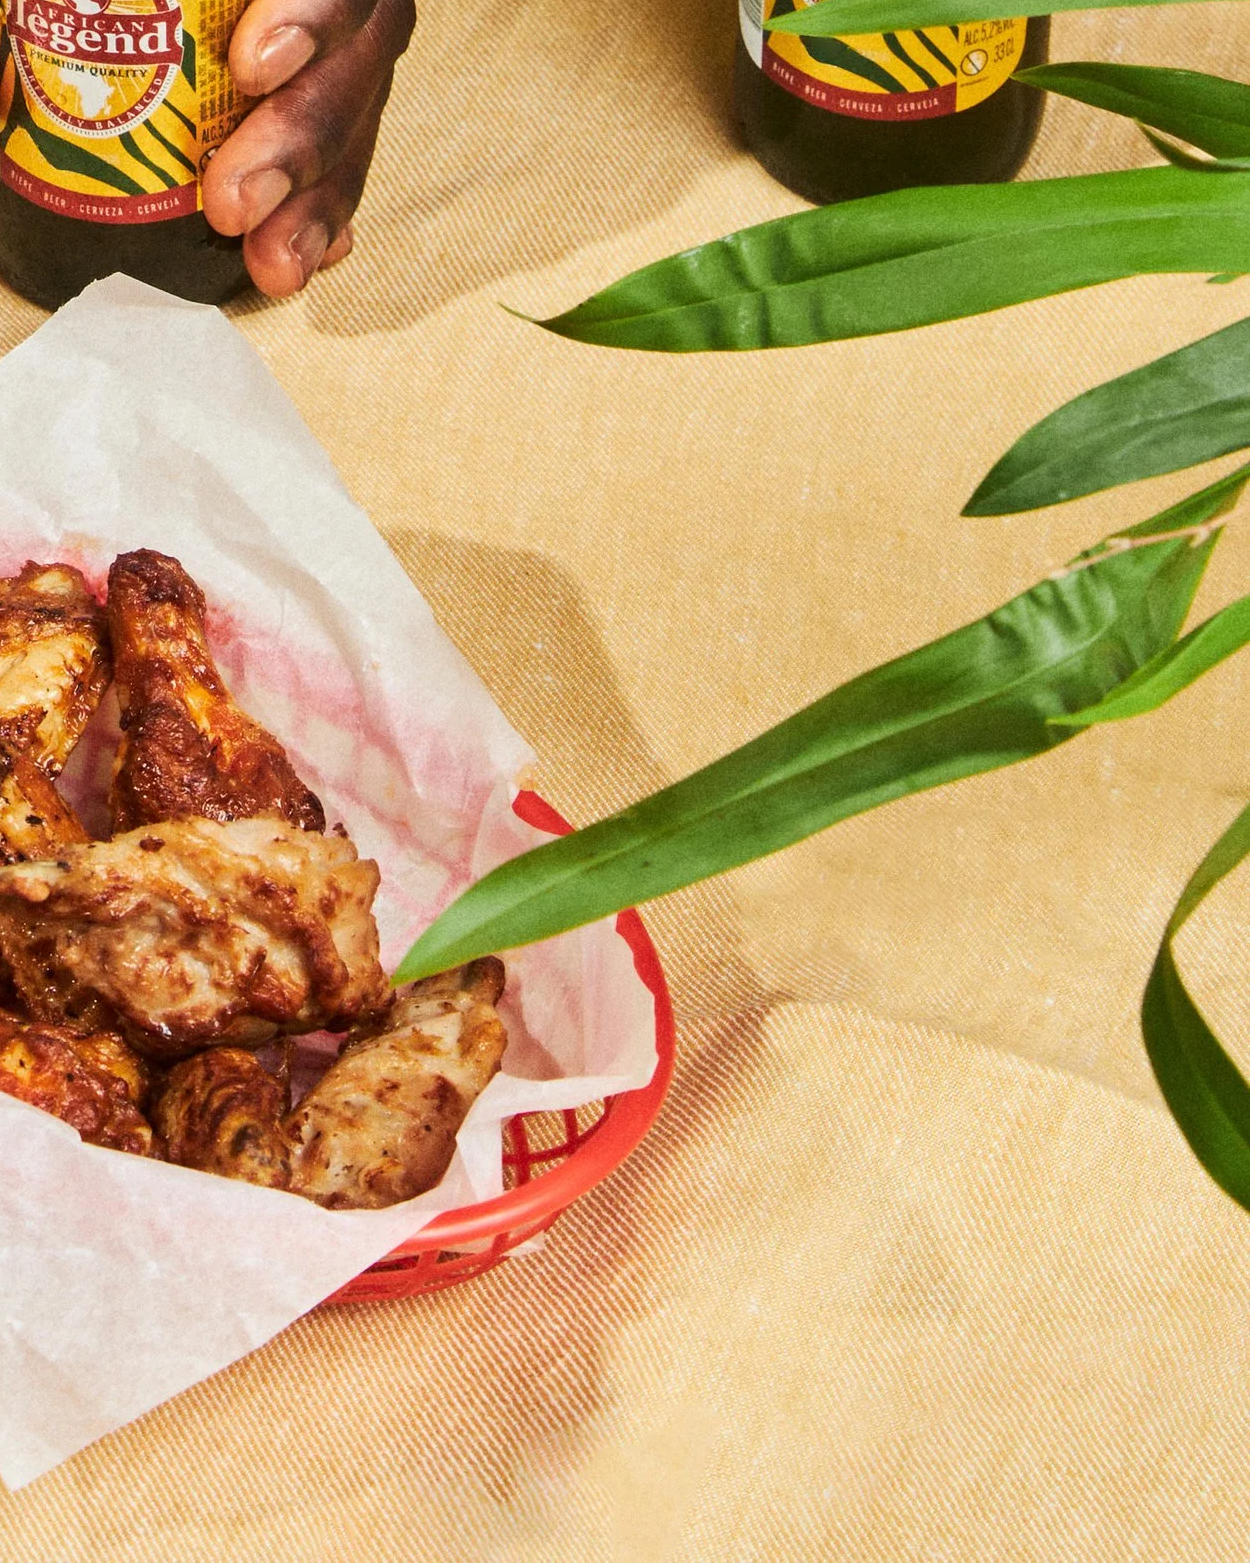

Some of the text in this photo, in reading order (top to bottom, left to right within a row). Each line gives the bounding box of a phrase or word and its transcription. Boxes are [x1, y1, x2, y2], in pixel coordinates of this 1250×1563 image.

[34, 3, 145, 32] AFRICAN
[29, 49, 147, 78] PREMIUM QUALITY
[95, 78, 163, 130] BALANCED
[805, 84, 827, 102] BEER
[839, 98, 883, 113] CERVEZA
[897, 98, 939, 113] CERVEJA
[44, 192, 66, 208] BEER
[79, 204, 124, 216] CERVEZA
[137, 197, 180, 215] CERVEJA
